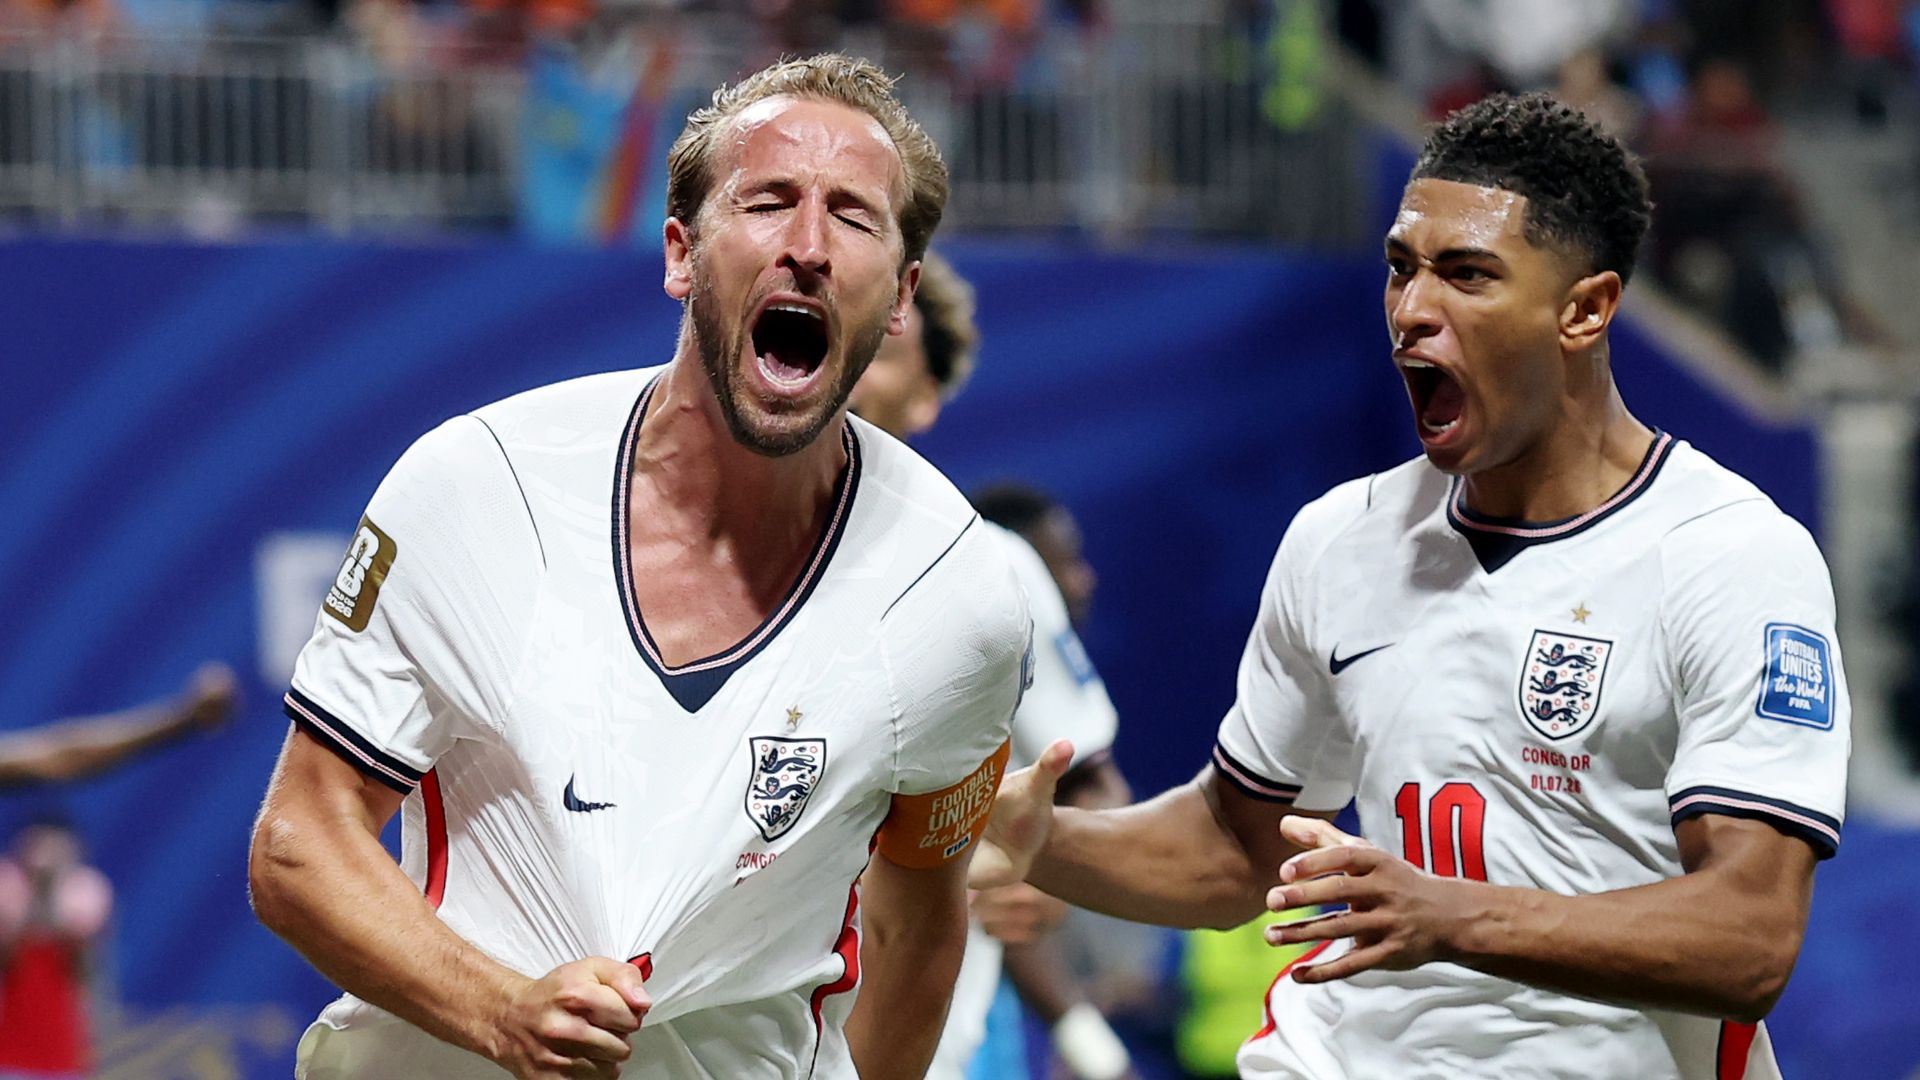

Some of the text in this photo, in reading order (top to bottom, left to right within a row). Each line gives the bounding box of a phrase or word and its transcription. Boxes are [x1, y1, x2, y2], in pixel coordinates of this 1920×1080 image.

[1780, 638, 1822, 665] FOOTBALL
[1780, 652, 1823, 684] UNITES
[1774, 675, 1826, 704] the World
[1788, 696, 1812, 711] FIFA
[1522, 747, 1591, 771] CONGO DR
[931, 761, 997, 814] FOOTBALL
[1531, 774, 1582, 794] 01.07.26
[929, 776, 995, 832] UNITES
[919, 832, 952, 849] the
[1394, 782, 1488, 883] 10
